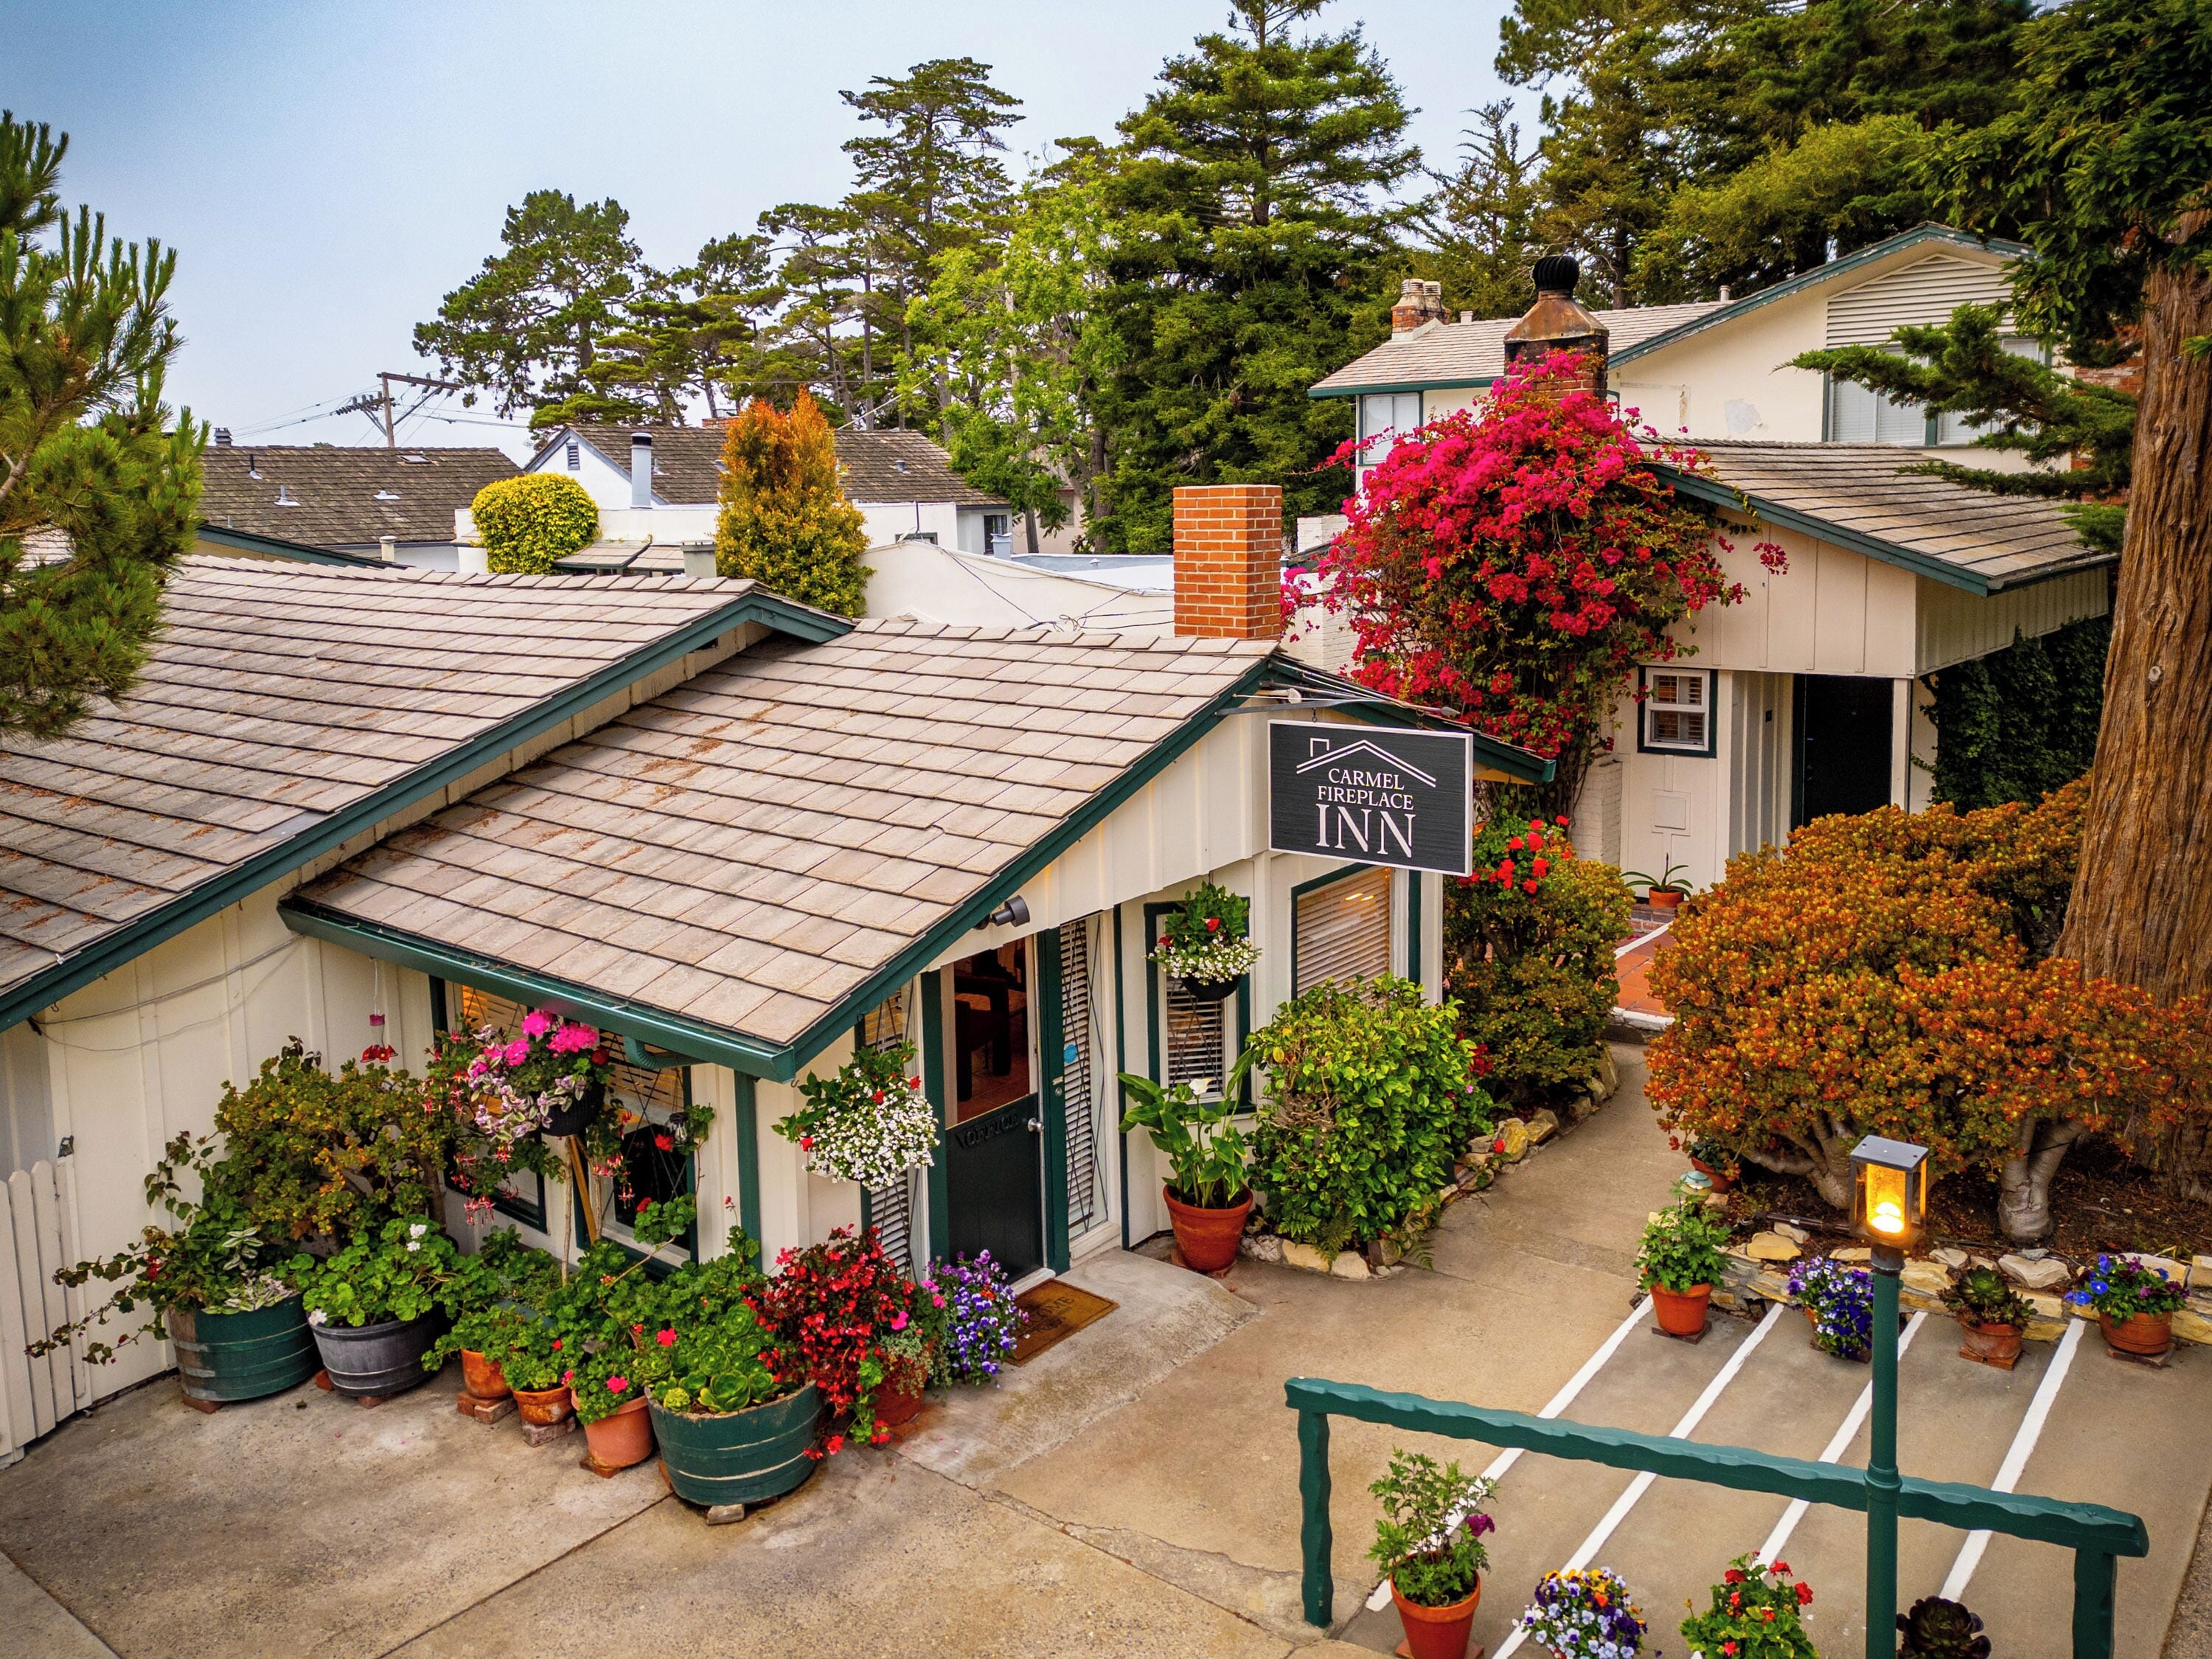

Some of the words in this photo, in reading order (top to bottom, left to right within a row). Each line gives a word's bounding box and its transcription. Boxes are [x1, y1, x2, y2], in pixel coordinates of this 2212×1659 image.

[1328, 768, 1405, 790] CARMEL
[1317, 785, 1414, 810] FIREPLACE
[1315, 804, 1416, 858] INN
